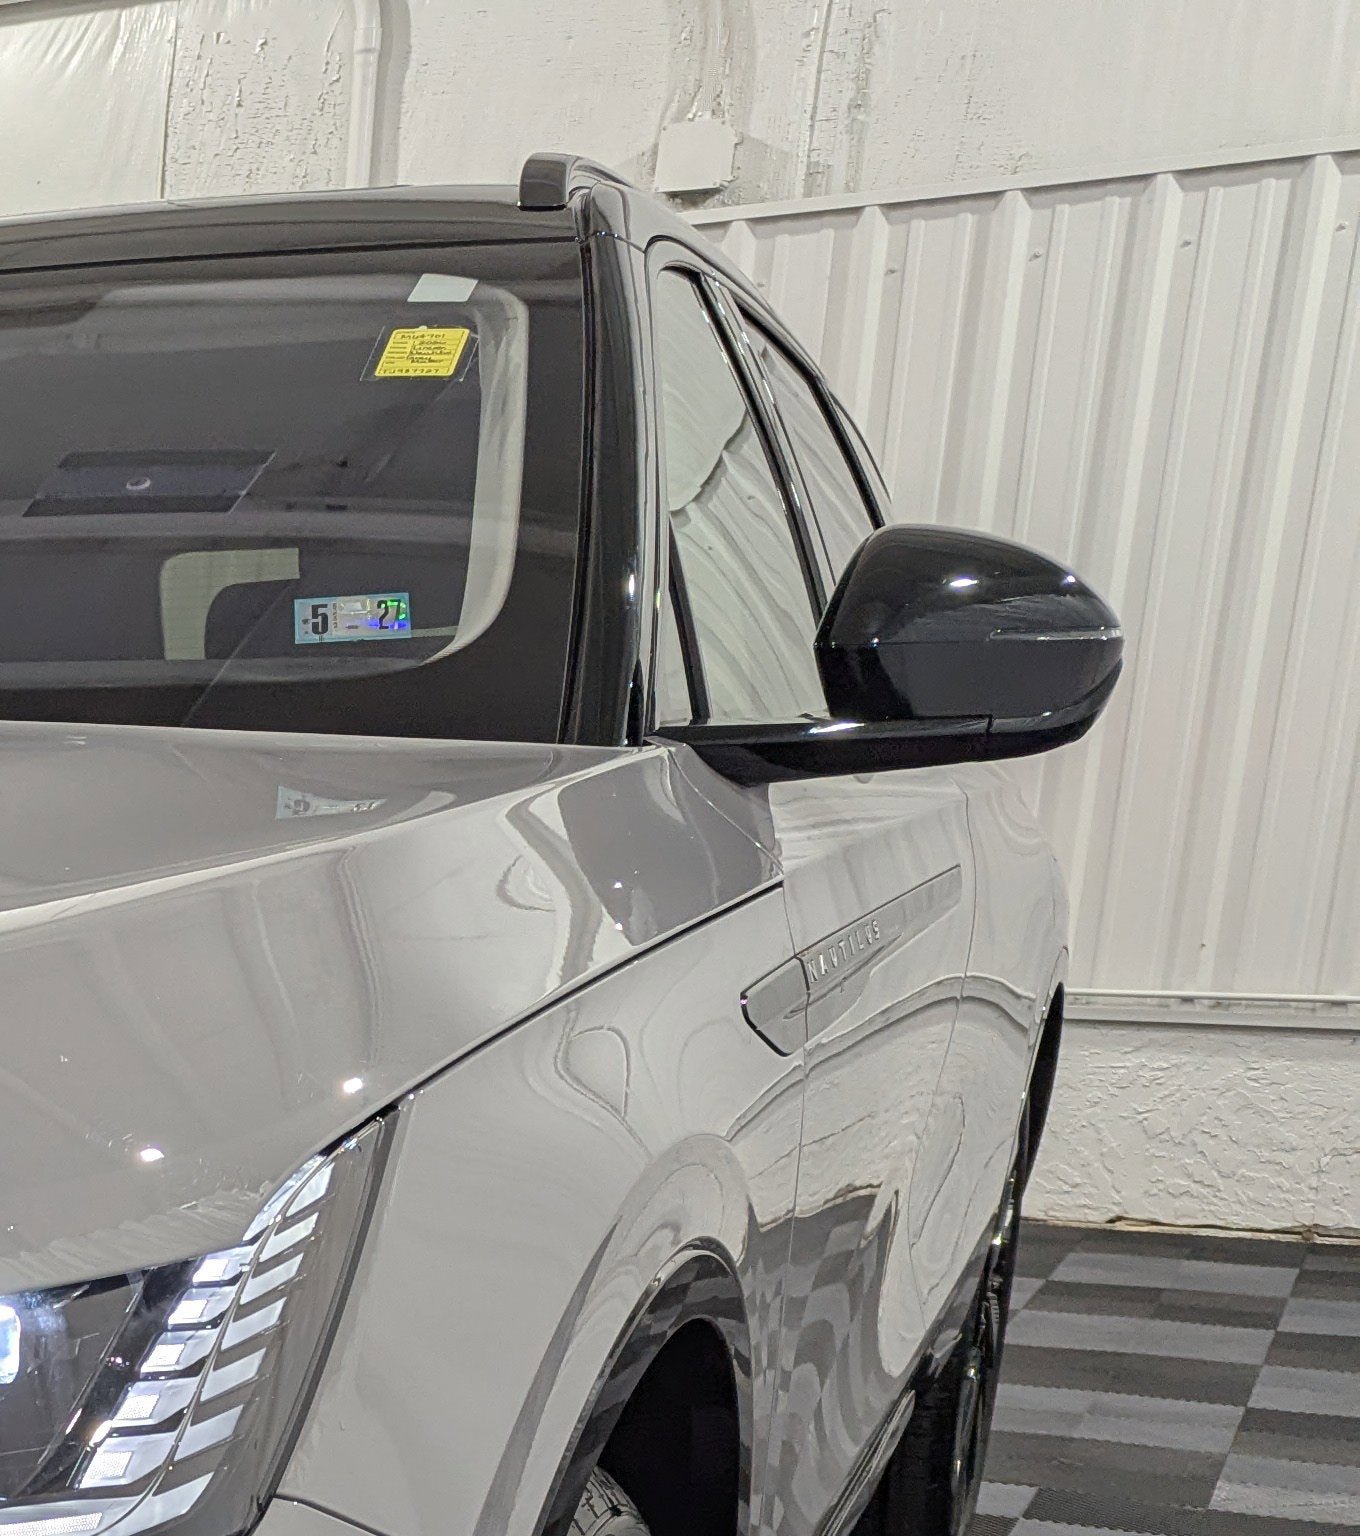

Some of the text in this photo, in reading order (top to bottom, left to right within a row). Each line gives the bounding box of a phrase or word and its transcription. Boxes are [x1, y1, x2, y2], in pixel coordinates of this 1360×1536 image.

[311, 603, 329, 635] 5
[377, 599, 401, 629] 27
[807, 919, 880, 983] NAUTILUS
